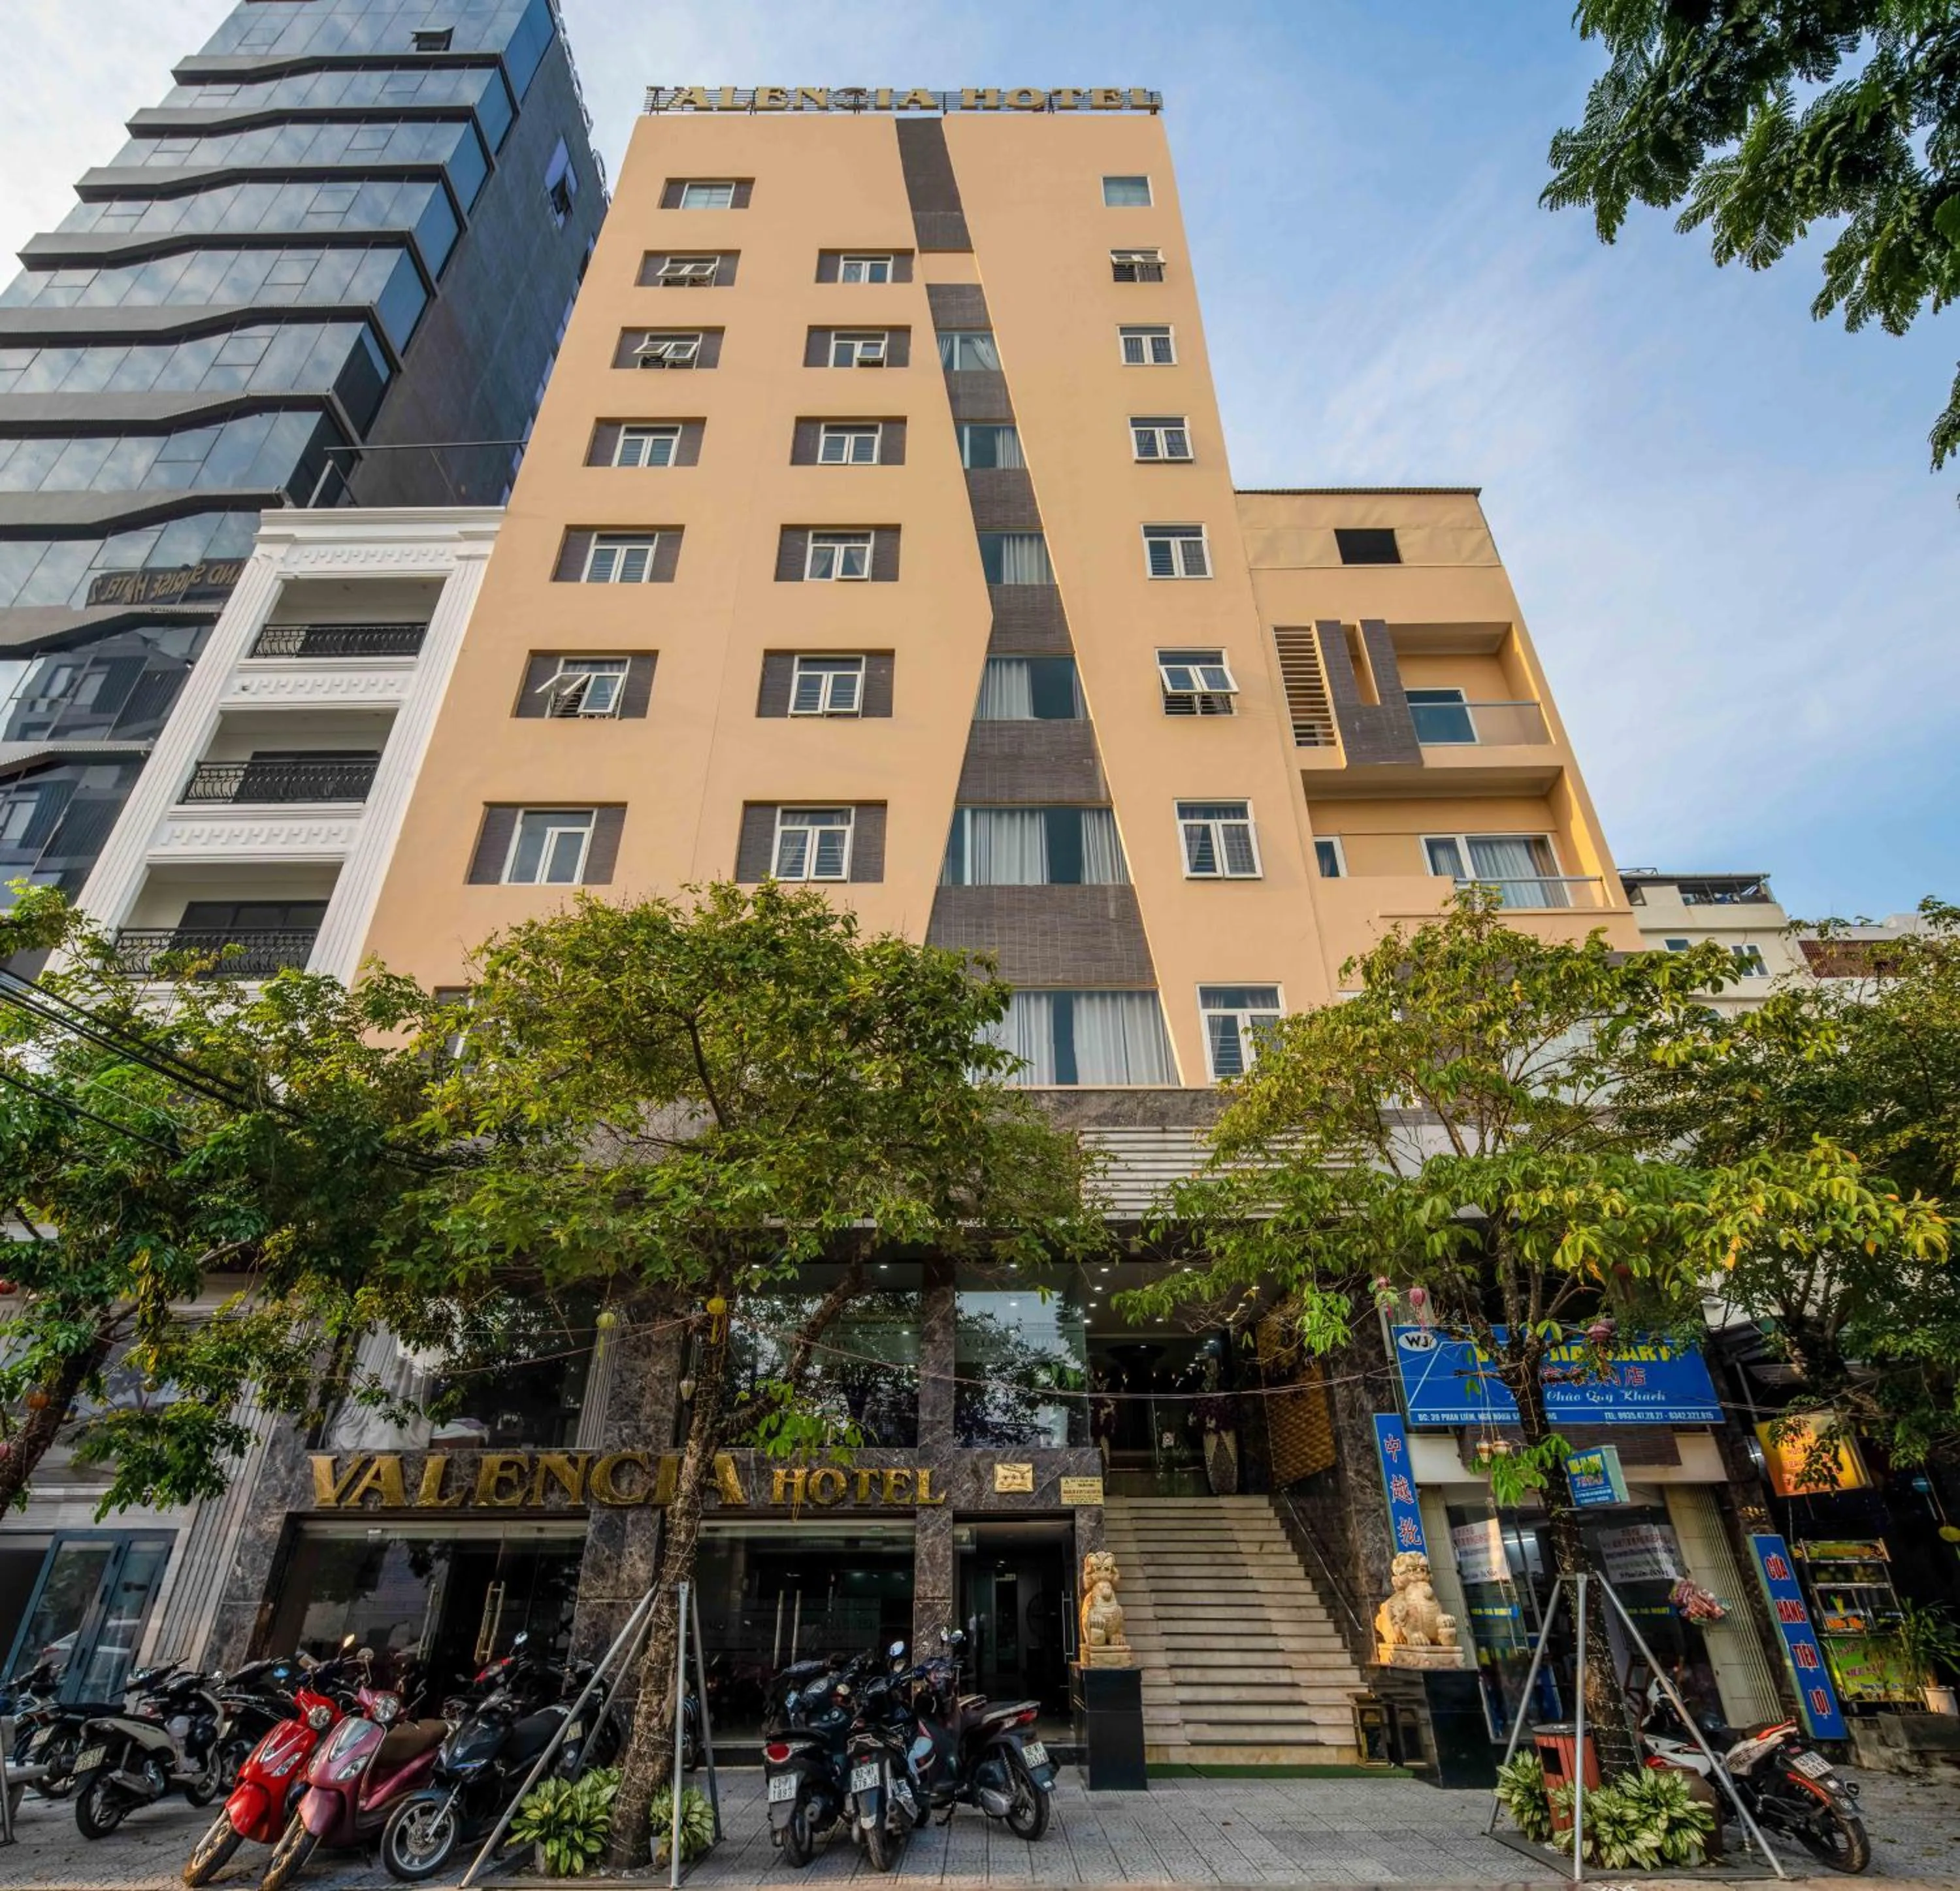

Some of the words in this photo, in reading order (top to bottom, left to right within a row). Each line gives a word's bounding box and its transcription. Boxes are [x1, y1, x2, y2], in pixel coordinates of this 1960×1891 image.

[961, 87, 1160, 111] HOTEL
[306, 1451, 750, 1508] VALENCIA
[768, 1467, 947, 1507] HOTEL
